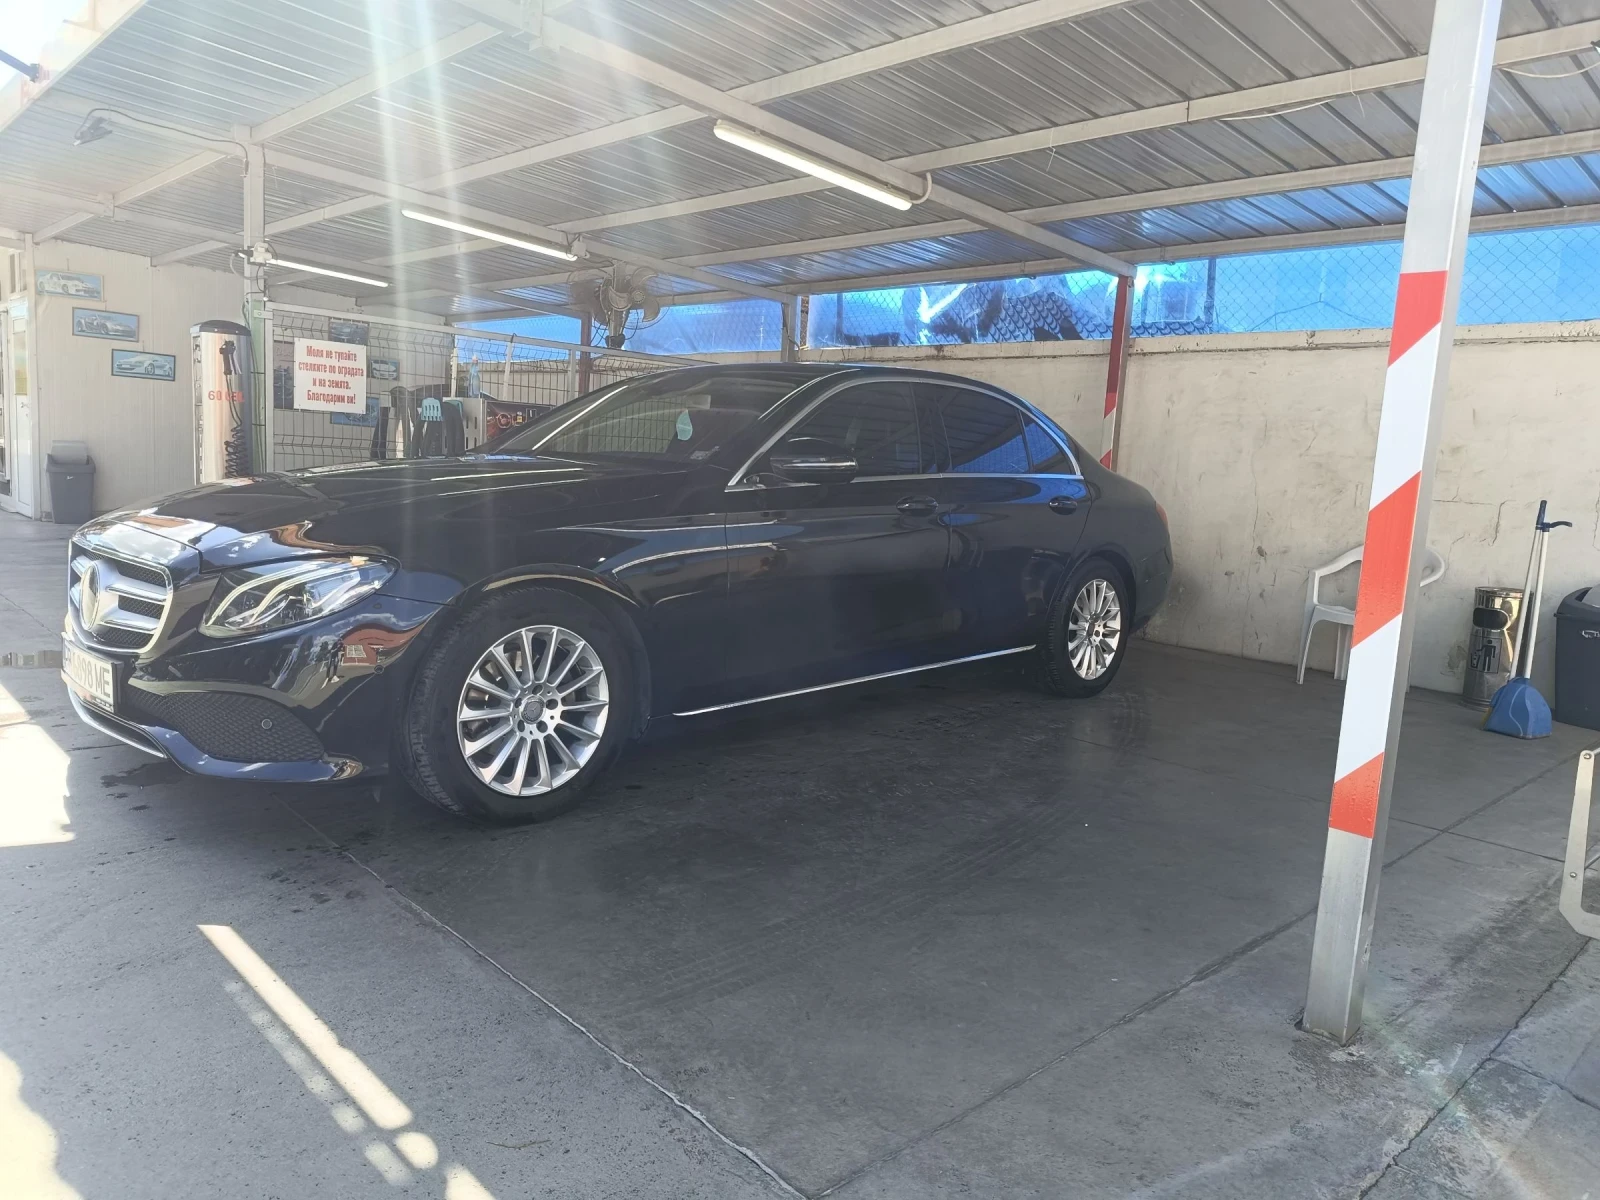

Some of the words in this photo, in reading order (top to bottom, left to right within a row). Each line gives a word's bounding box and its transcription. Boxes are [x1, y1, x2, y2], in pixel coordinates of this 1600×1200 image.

[306, 345, 324, 358] Моля
[325, 349, 334, 359] не
[334, 350, 357, 362] тупайте
[298, 361, 328, 373] стелките
[328, 365, 336, 374] по
[337, 365, 364, 378] оградата
[312, 377, 317, 387] и
[318, 378, 327, 387] на
[327, 379, 352, 390] земята.
[208, 390, 222, 401] 60
[307, 389, 346, 405] Благодарим
[346, 393, 356, 405] ви!
